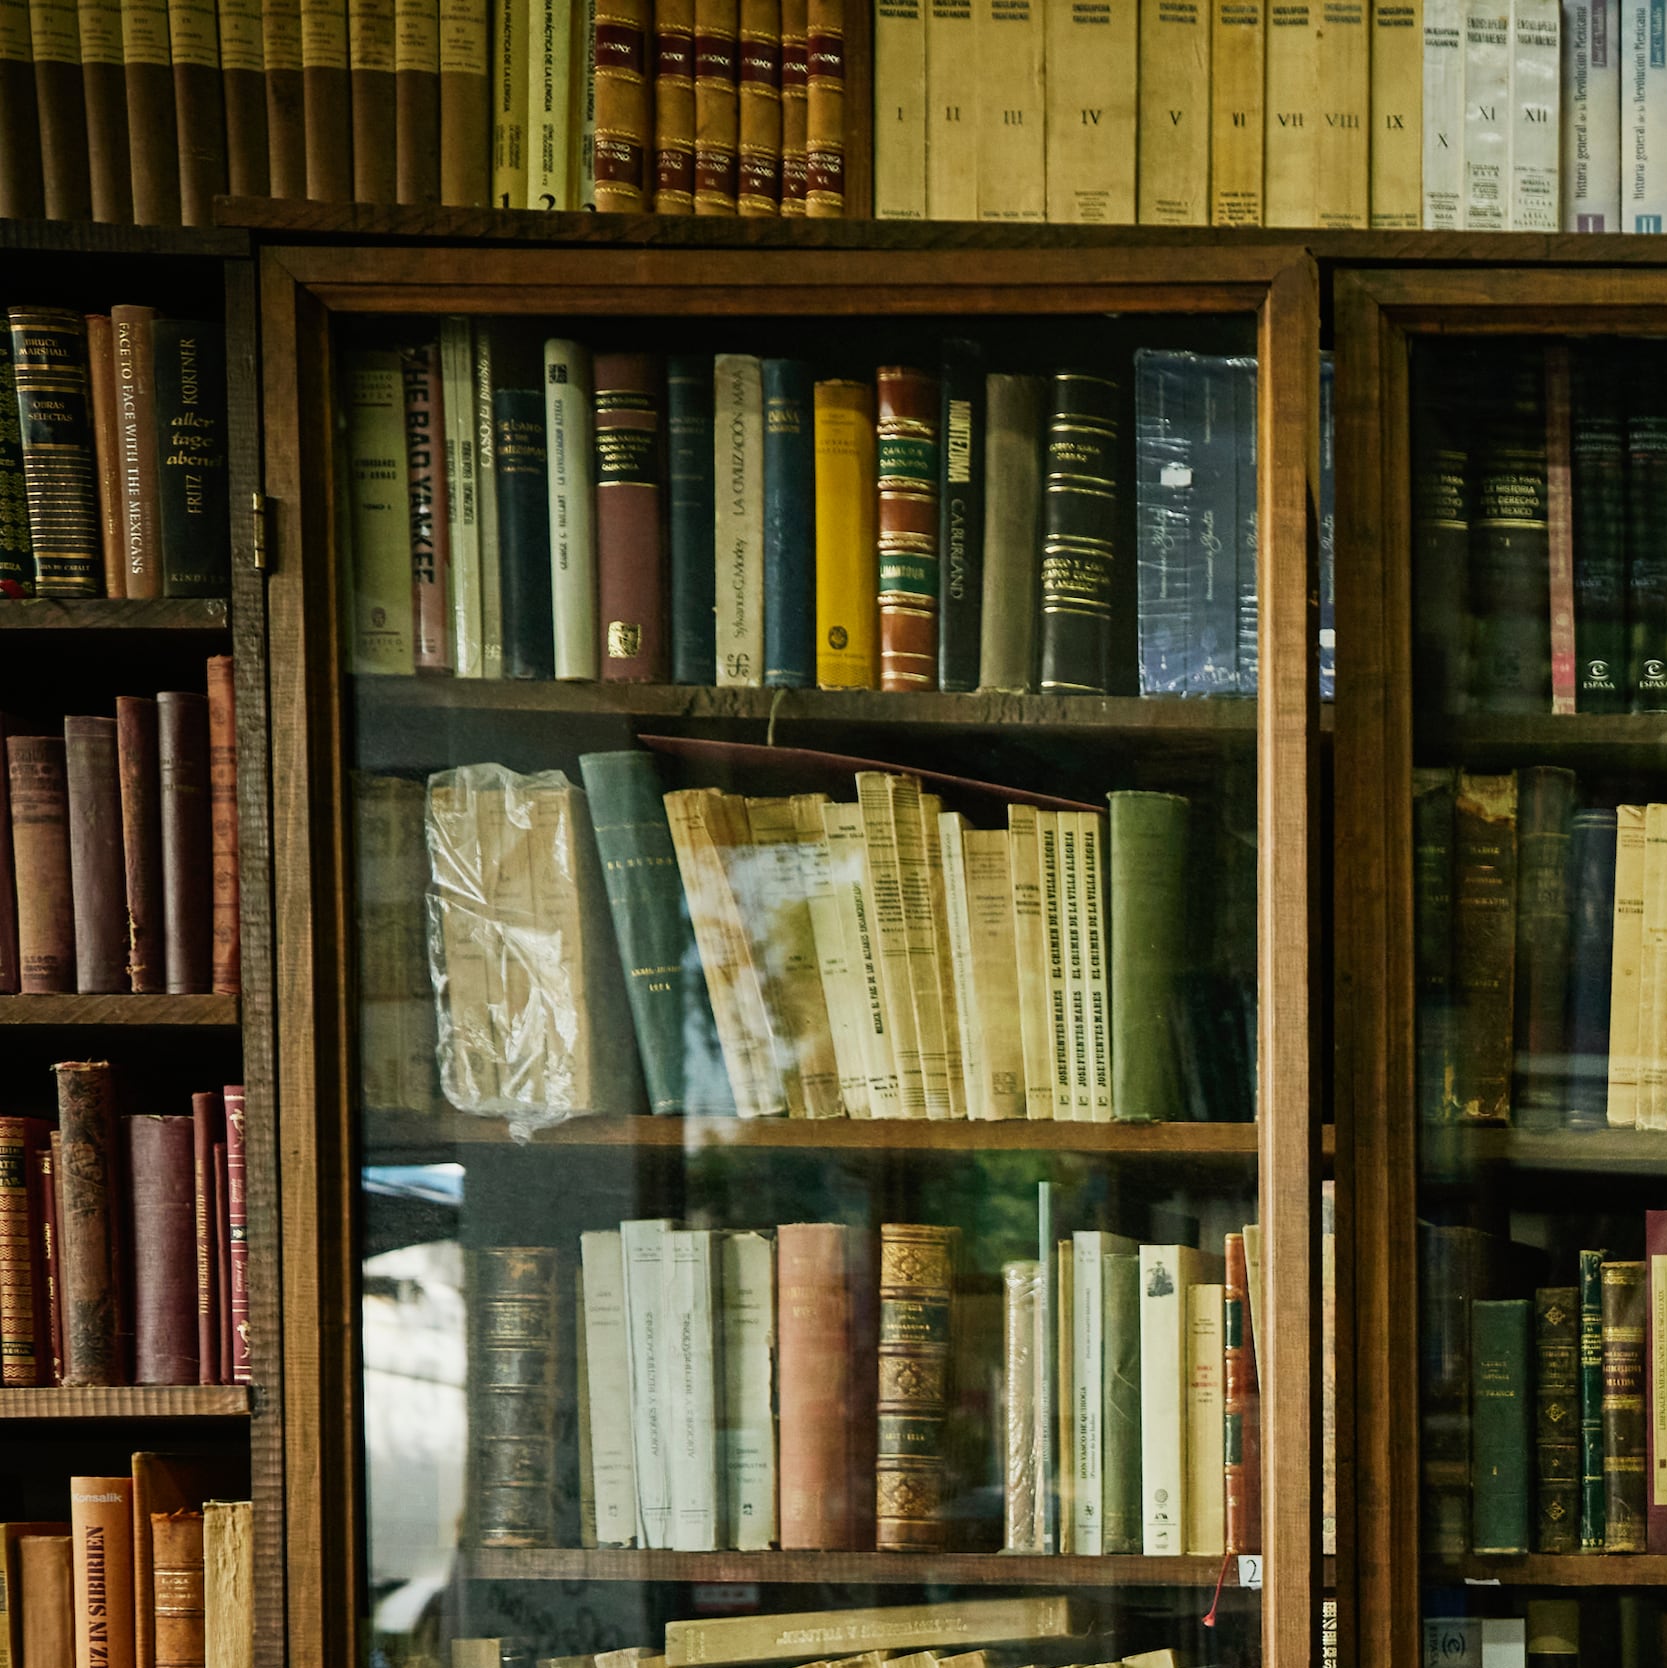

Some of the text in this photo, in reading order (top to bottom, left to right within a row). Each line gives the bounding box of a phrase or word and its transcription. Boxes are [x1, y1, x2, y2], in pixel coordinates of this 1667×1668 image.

[1081, 109, 1101, 125] IV
[1170, 111, 1182, 126] V
[1277, 113, 1303, 127] VII
[1478, 106, 1495, 120] XI
[1524, 107, 1548, 122] XII
[1387, 115, 1403, 129] IX
[948, 400, 970, 482] MONTEZUMA
[87, 1526, 106, 1616] SIBIRIEN
[1249, 1560, 1260, 1582] 2
[89, 1621, 107, 1642] IN
